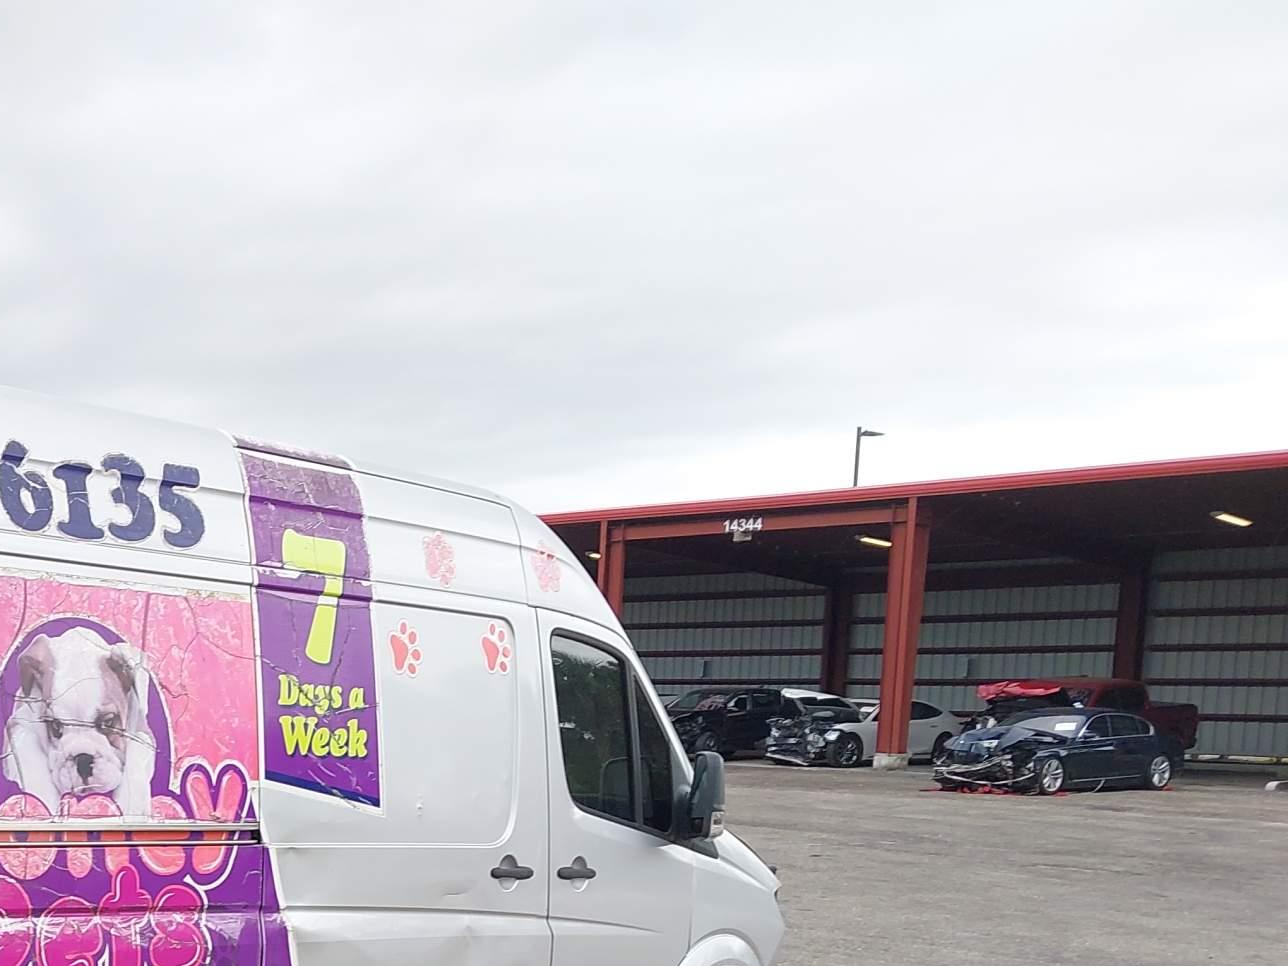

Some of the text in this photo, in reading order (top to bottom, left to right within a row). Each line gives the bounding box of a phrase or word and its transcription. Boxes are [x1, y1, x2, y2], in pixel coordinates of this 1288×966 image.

[723, 517, 763, 533] 14344
[281, 528, 347, 665] 7
[278, 674, 365, 716] Days a
[279, 715, 368, 758] Week
